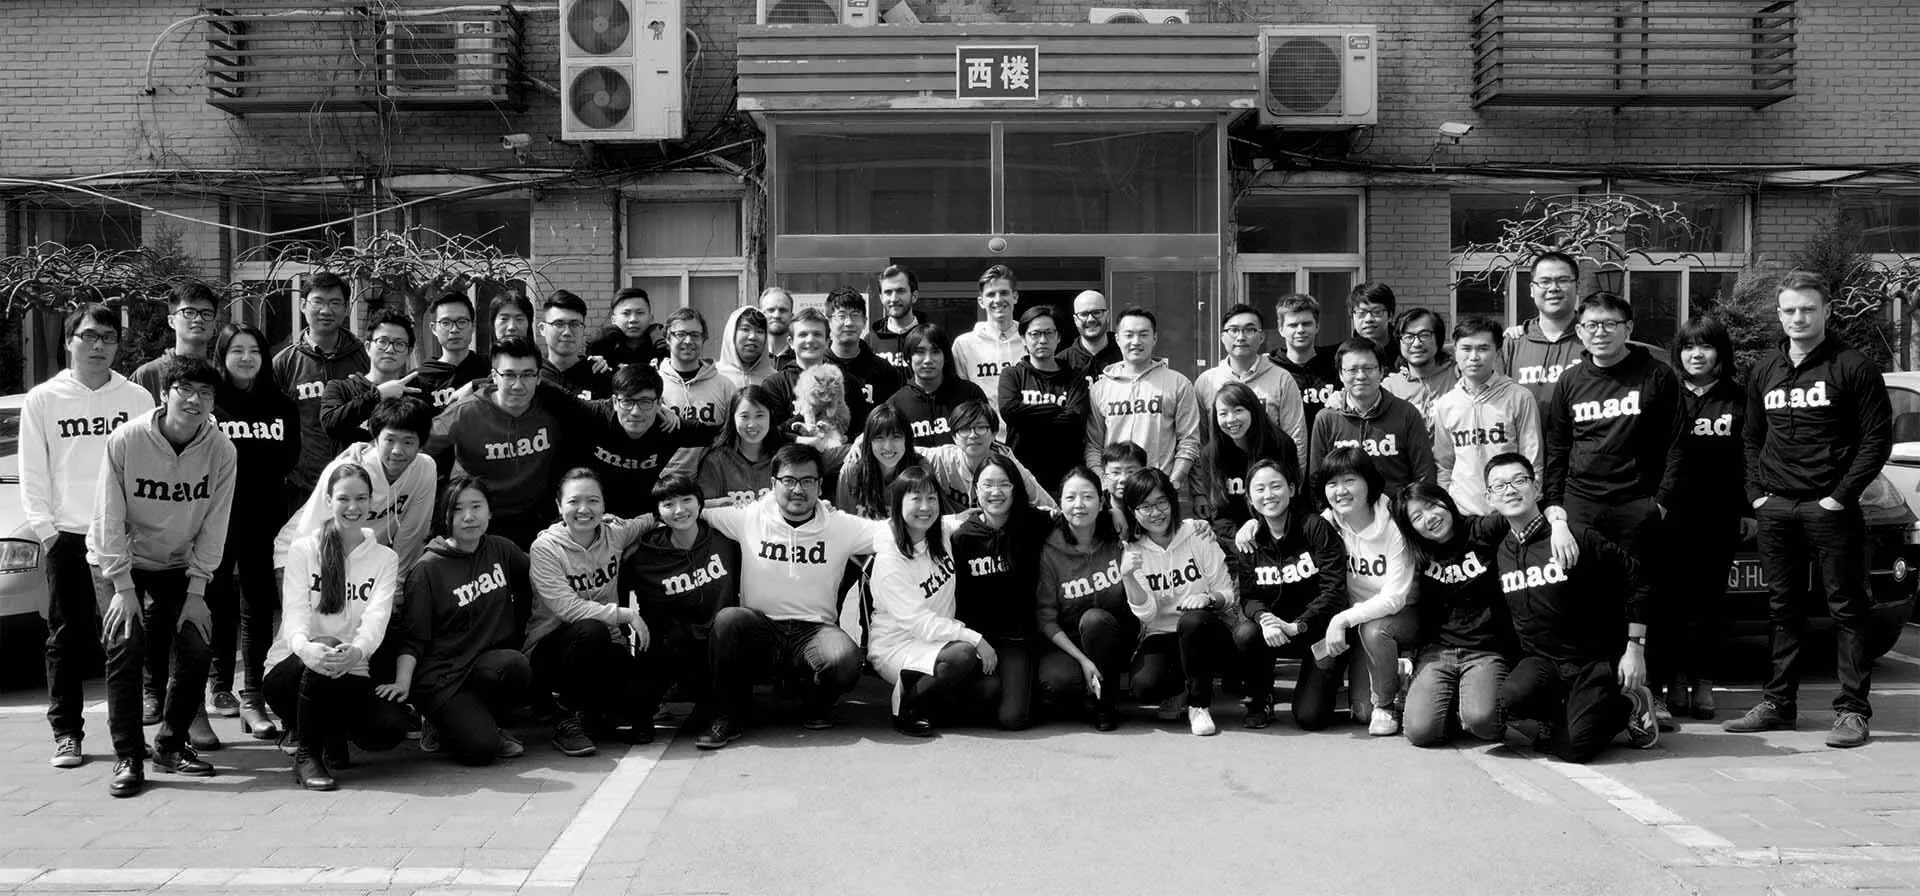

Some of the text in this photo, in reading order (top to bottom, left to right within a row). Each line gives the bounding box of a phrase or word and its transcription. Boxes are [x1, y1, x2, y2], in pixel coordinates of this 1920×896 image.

[965, 55, 1029, 90] 西楼
[1107, 396, 1163, 417] mad
[1303, 383, 1334, 404] ad
[1572, 391, 1641, 423] mad
[1763, 381, 1831, 410] mad
[58, 412, 129, 439] mad
[219, 418, 285, 442] mad
[910, 416, 951, 438] ma
[1452, 422, 1509, 448] mad
[1690, 413, 1733, 437] ad
[485, 427, 551, 460] mad
[594, 446, 659, 470] mad
[133, 474, 210, 502] mad
[758, 539, 828, 565] mad
[567, 555, 618, 593] mad
[661, 553, 729, 596] mad
[1060, 559, 1122, 601] mad
[1145, 558, 1203, 592] mad
[1253, 551, 1320, 586] mad
[1501, 557, 1569, 594] mad
[452, 562, 508, 608] mad
